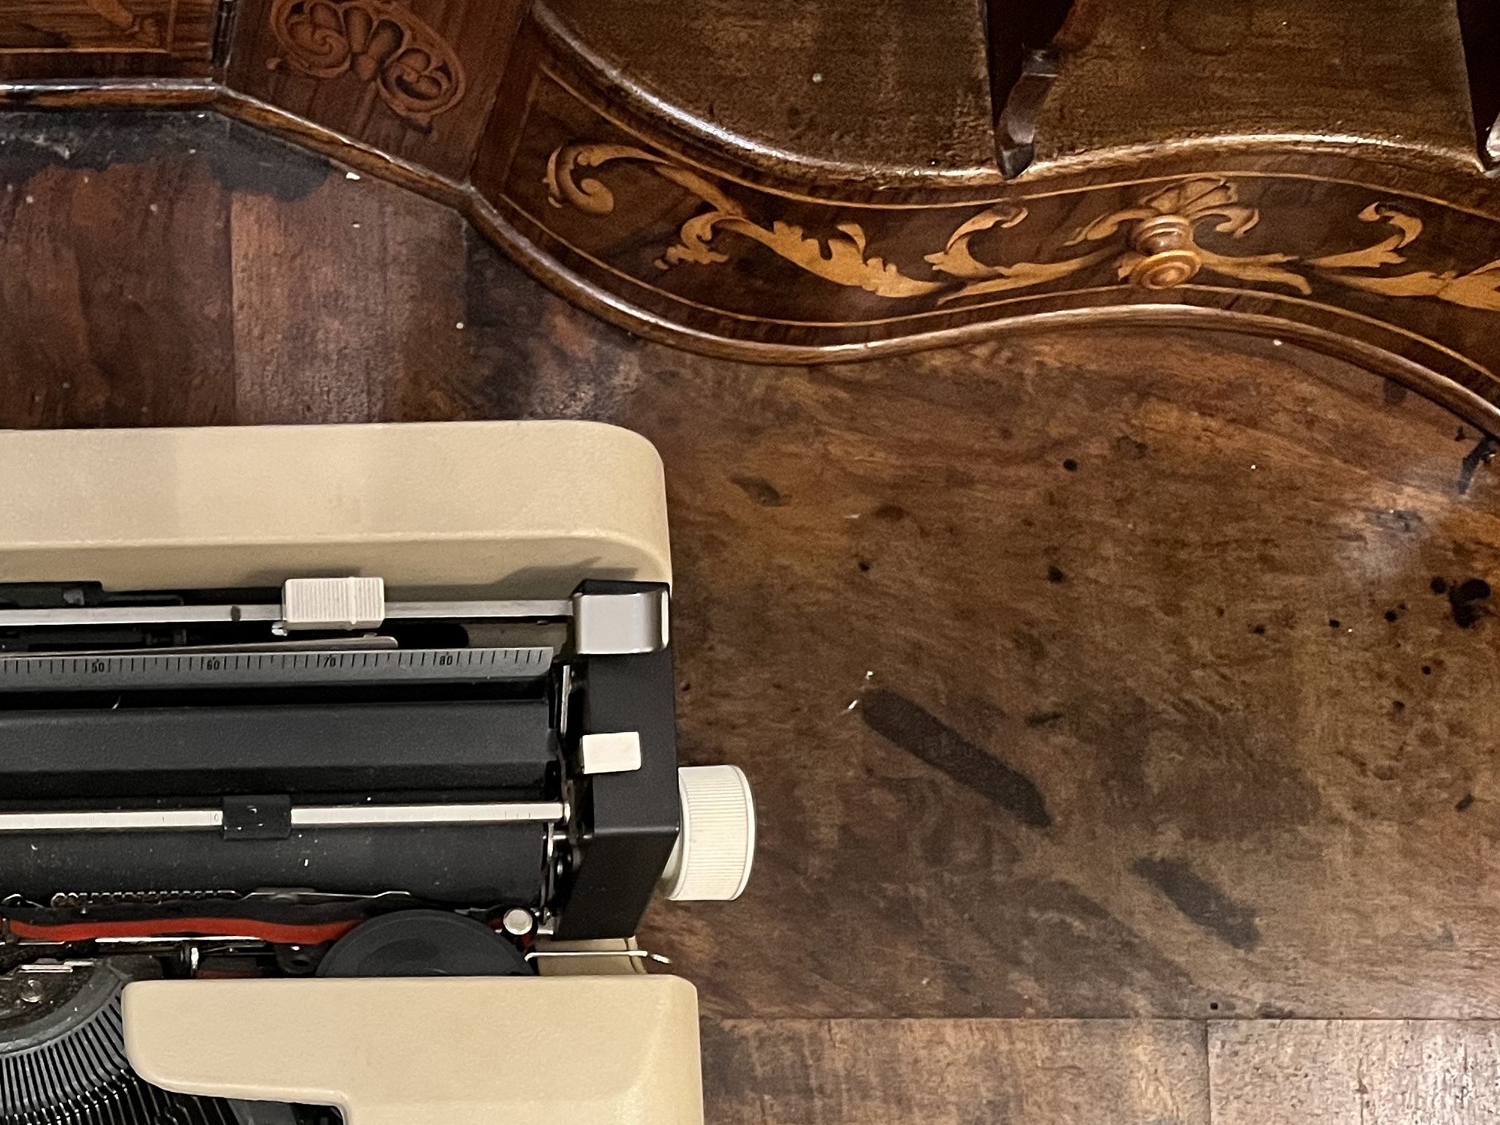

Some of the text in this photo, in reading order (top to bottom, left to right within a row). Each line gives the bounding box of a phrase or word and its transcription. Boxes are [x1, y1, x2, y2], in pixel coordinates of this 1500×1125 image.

[91, 662, 105, 674] 50
[206, 659, 220, 671] 60
[439, 654, 454, 666] 80
